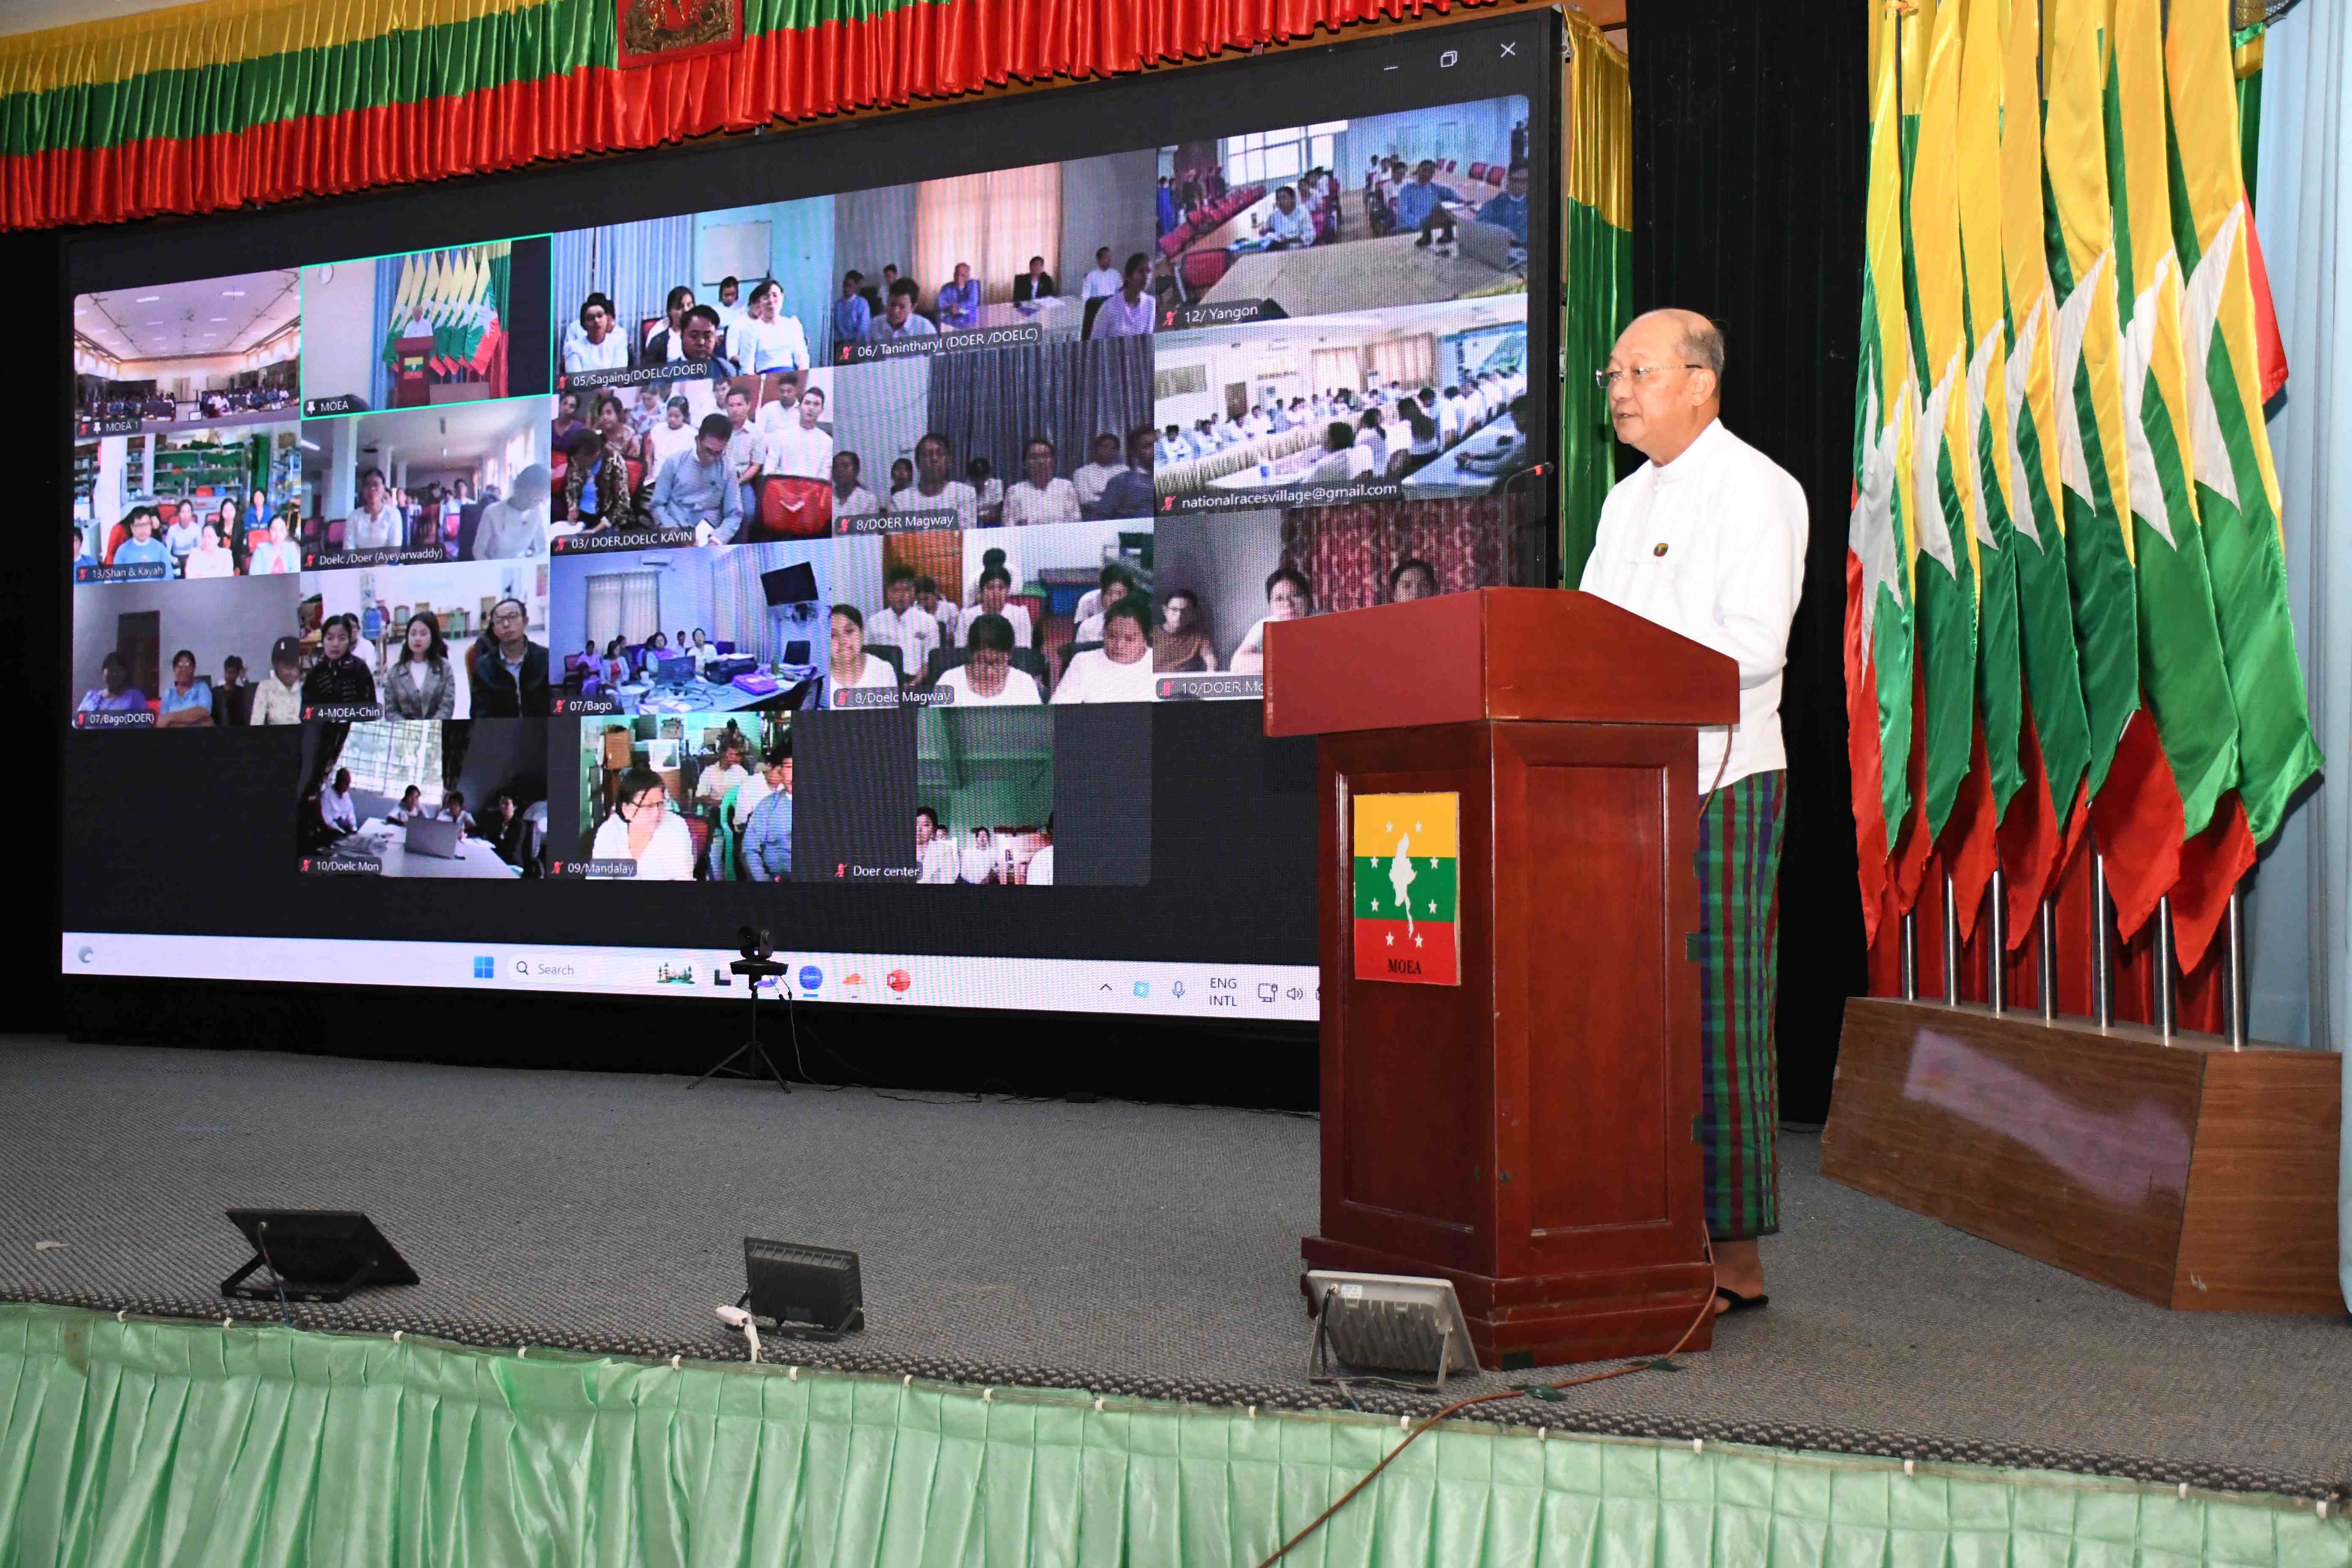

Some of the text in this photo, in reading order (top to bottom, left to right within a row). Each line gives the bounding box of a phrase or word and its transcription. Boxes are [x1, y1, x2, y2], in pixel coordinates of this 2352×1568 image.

[1185, 306, 1258, 323] 12/ Yangon
[858, 345, 878, 358] 06/
[946, 335, 984, 350] (DOER
[987, 328, 1038, 345] /DOELC)
[573, 363, 707, 387] 05/Sagaing(DOELC/DOER)
[321, 400, 349, 412] MOEA
[106, 422, 132, 432] MOEA
[1181, 485, 1397, 509] nationalracesvillage@gmail.com
[856, 515, 954, 531] 8/DOER Magway
[572, 538, 589, 549] 03/
[661, 531, 692, 544] KAYIN
[320, 548, 443, 565] Doelc /Doer (Ayeyarwaddy)
[92, 568, 126, 579] 13/Shan
[139, 566, 163, 576] Kayah
[1183, 681, 1241, 694] 10/DOER
[855, 691, 950, 705] 8/Doelc Magway
[318, 707, 380, 717] 4-MOEA-Chin
[570, 701, 612, 713] 07/Bago
[90, 713, 154, 726] 07/Bago(DOER)
[317, 861, 379, 871] 10/Doelc Mon
[568, 863, 634, 875] 09/Mandalay
[853, 865, 920, 877] Doer center
[538, 964, 574, 975] Search
[1388, 958, 1422, 975] MOEA
[1210, 977, 1237, 989] ENG
[1209, 995, 1238, 1007] INTL
